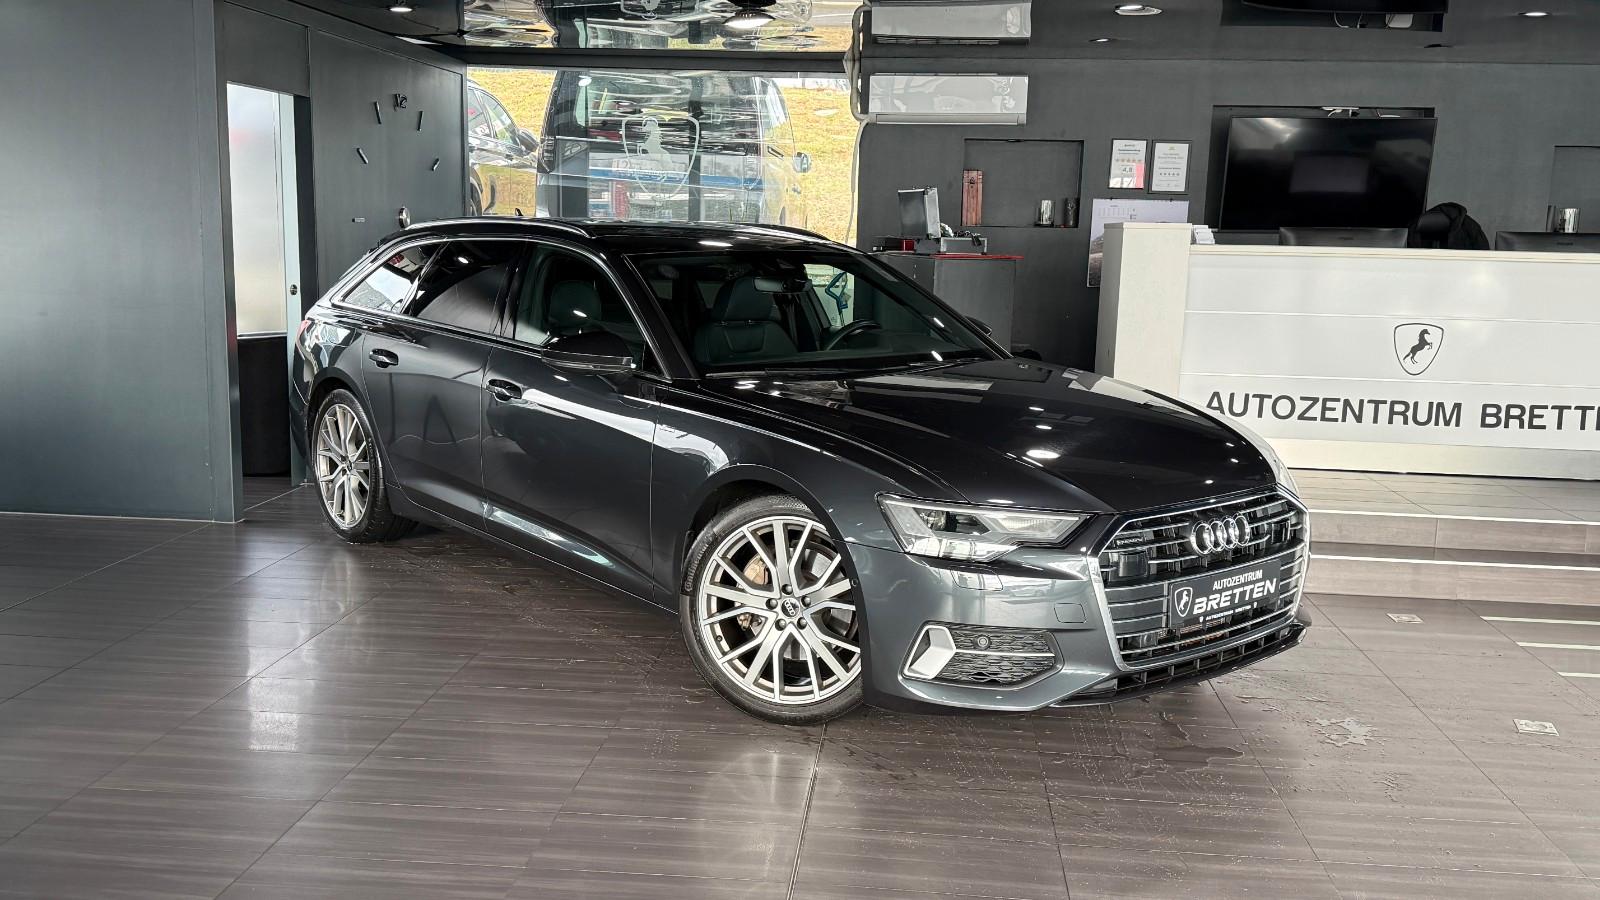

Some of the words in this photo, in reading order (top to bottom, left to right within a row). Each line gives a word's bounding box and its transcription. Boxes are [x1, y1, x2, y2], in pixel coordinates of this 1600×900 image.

[1206, 391, 1462, 428] AUTOZENTRUM
[1480, 403, 1600, 431] BRETT
[1192, 578, 1277, 615] BRETTEN
[1212, 569, 1263, 591] AUTOZENTRUM
